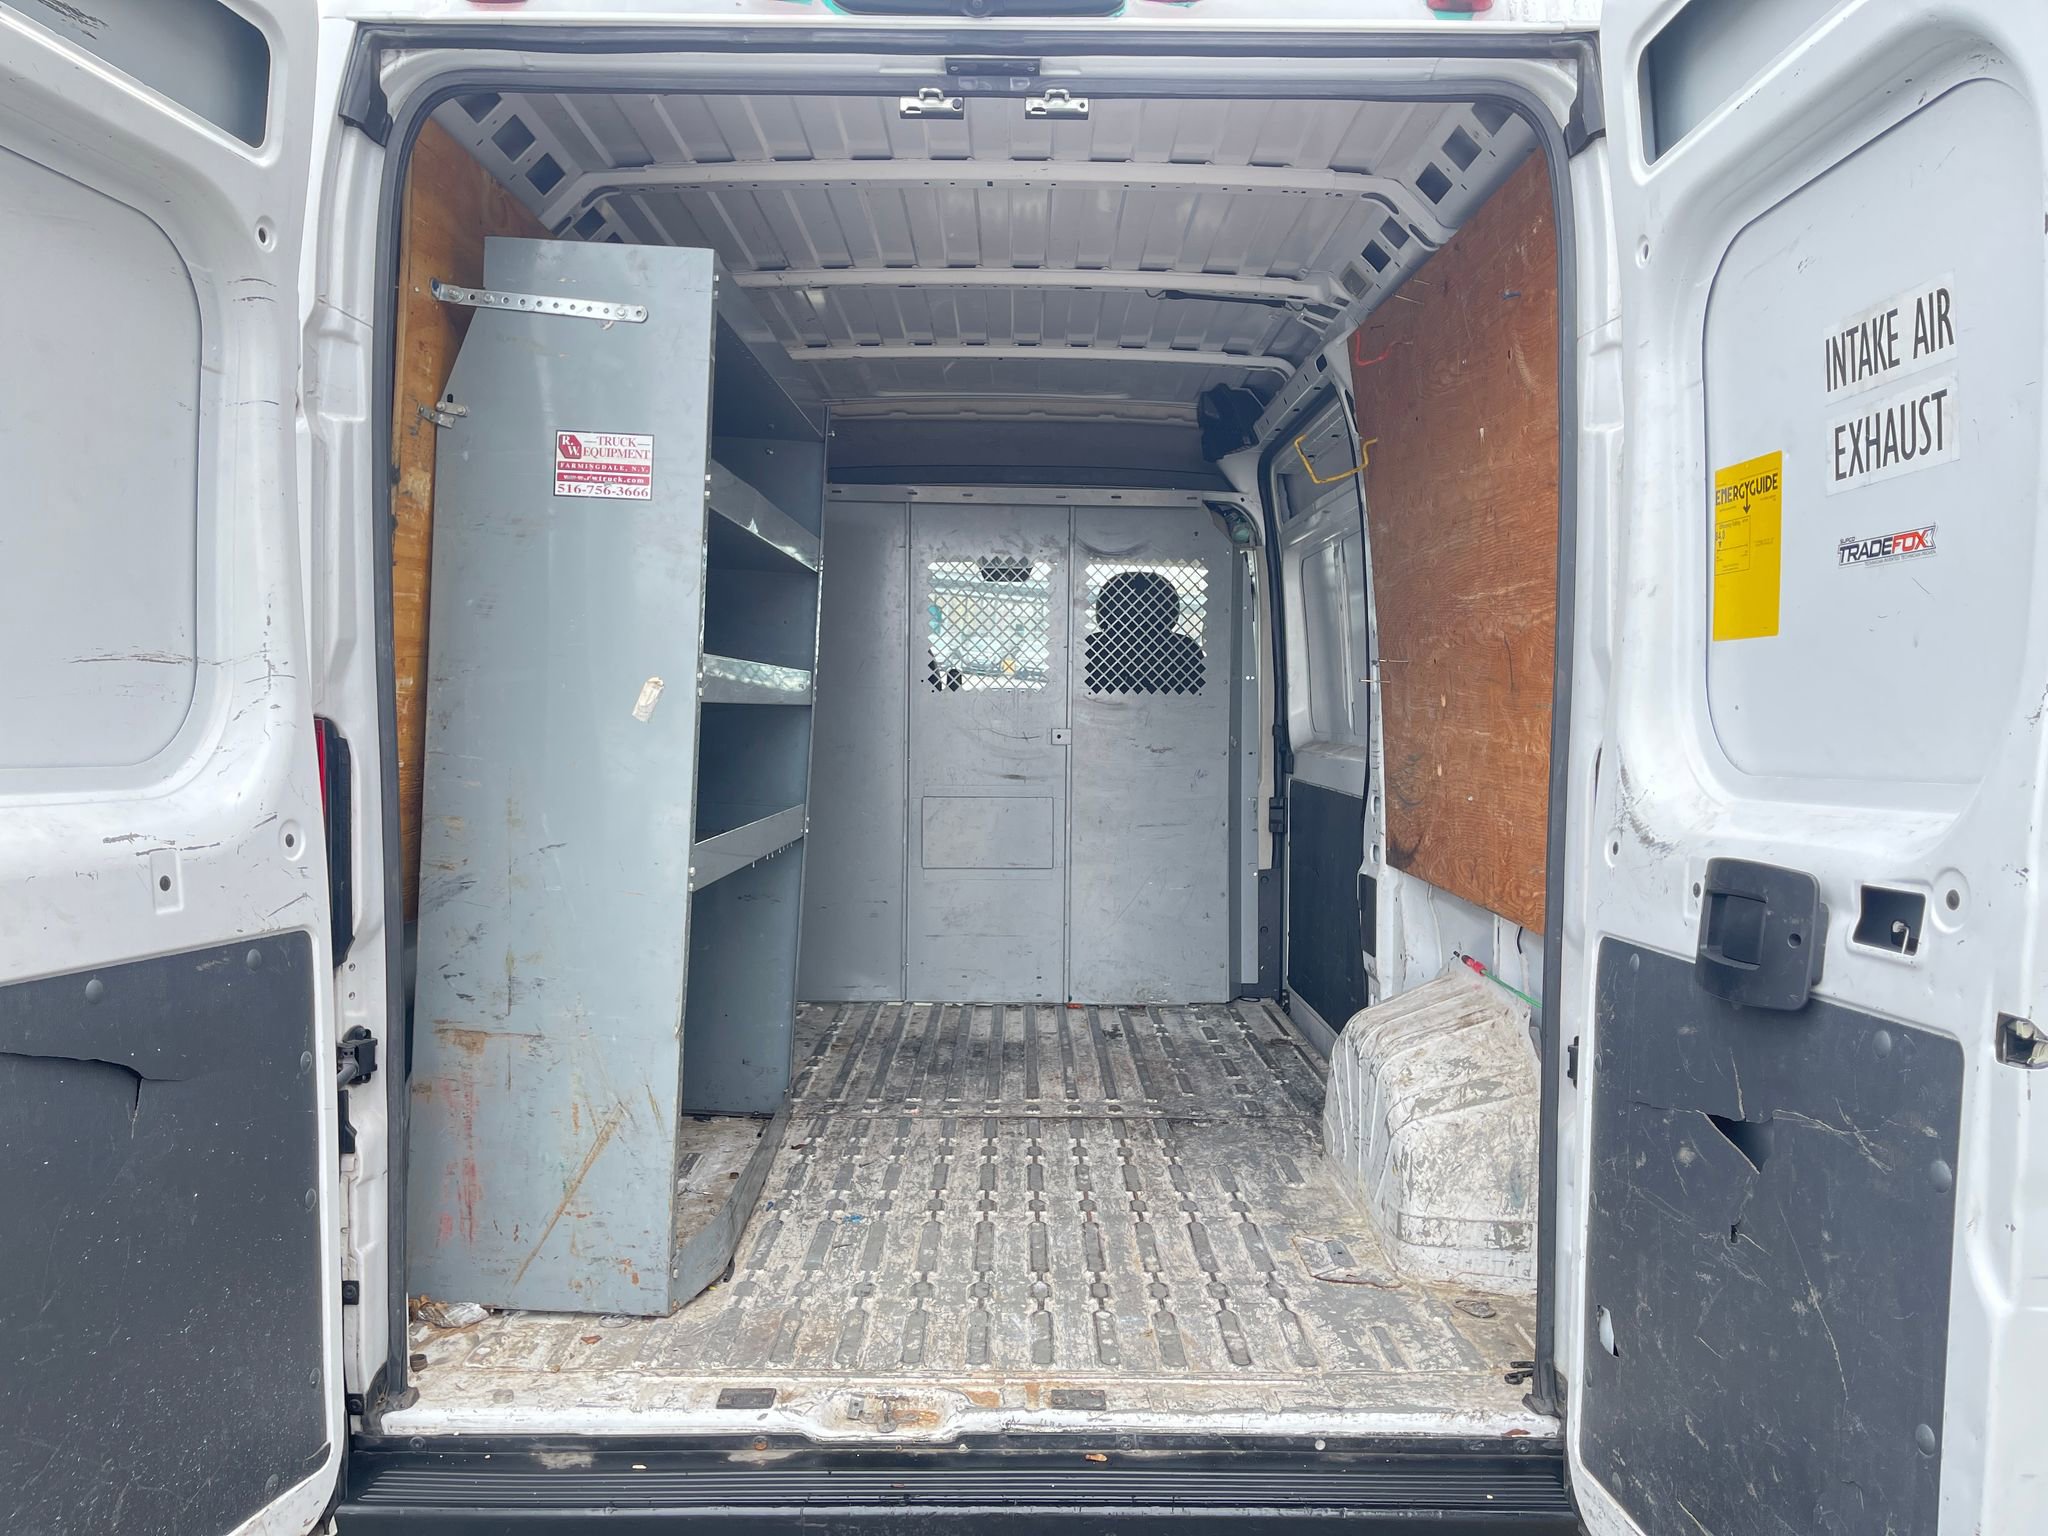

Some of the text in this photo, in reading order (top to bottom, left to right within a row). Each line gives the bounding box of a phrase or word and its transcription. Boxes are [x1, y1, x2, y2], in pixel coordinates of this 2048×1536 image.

[1825, 287, 1954, 392] INTAKE AIR
[1834, 388, 1948, 481] EXHAUST
[597, 436, 636, 448] TRUCK
[583, 447, 650, 459] EQUIPMENT
[563, 474, 645, 484] ww.rwtruck.com
[557, 483, 649, 497] 516-756-3666
[1839, 530, 1931, 563] TRADEFOX
